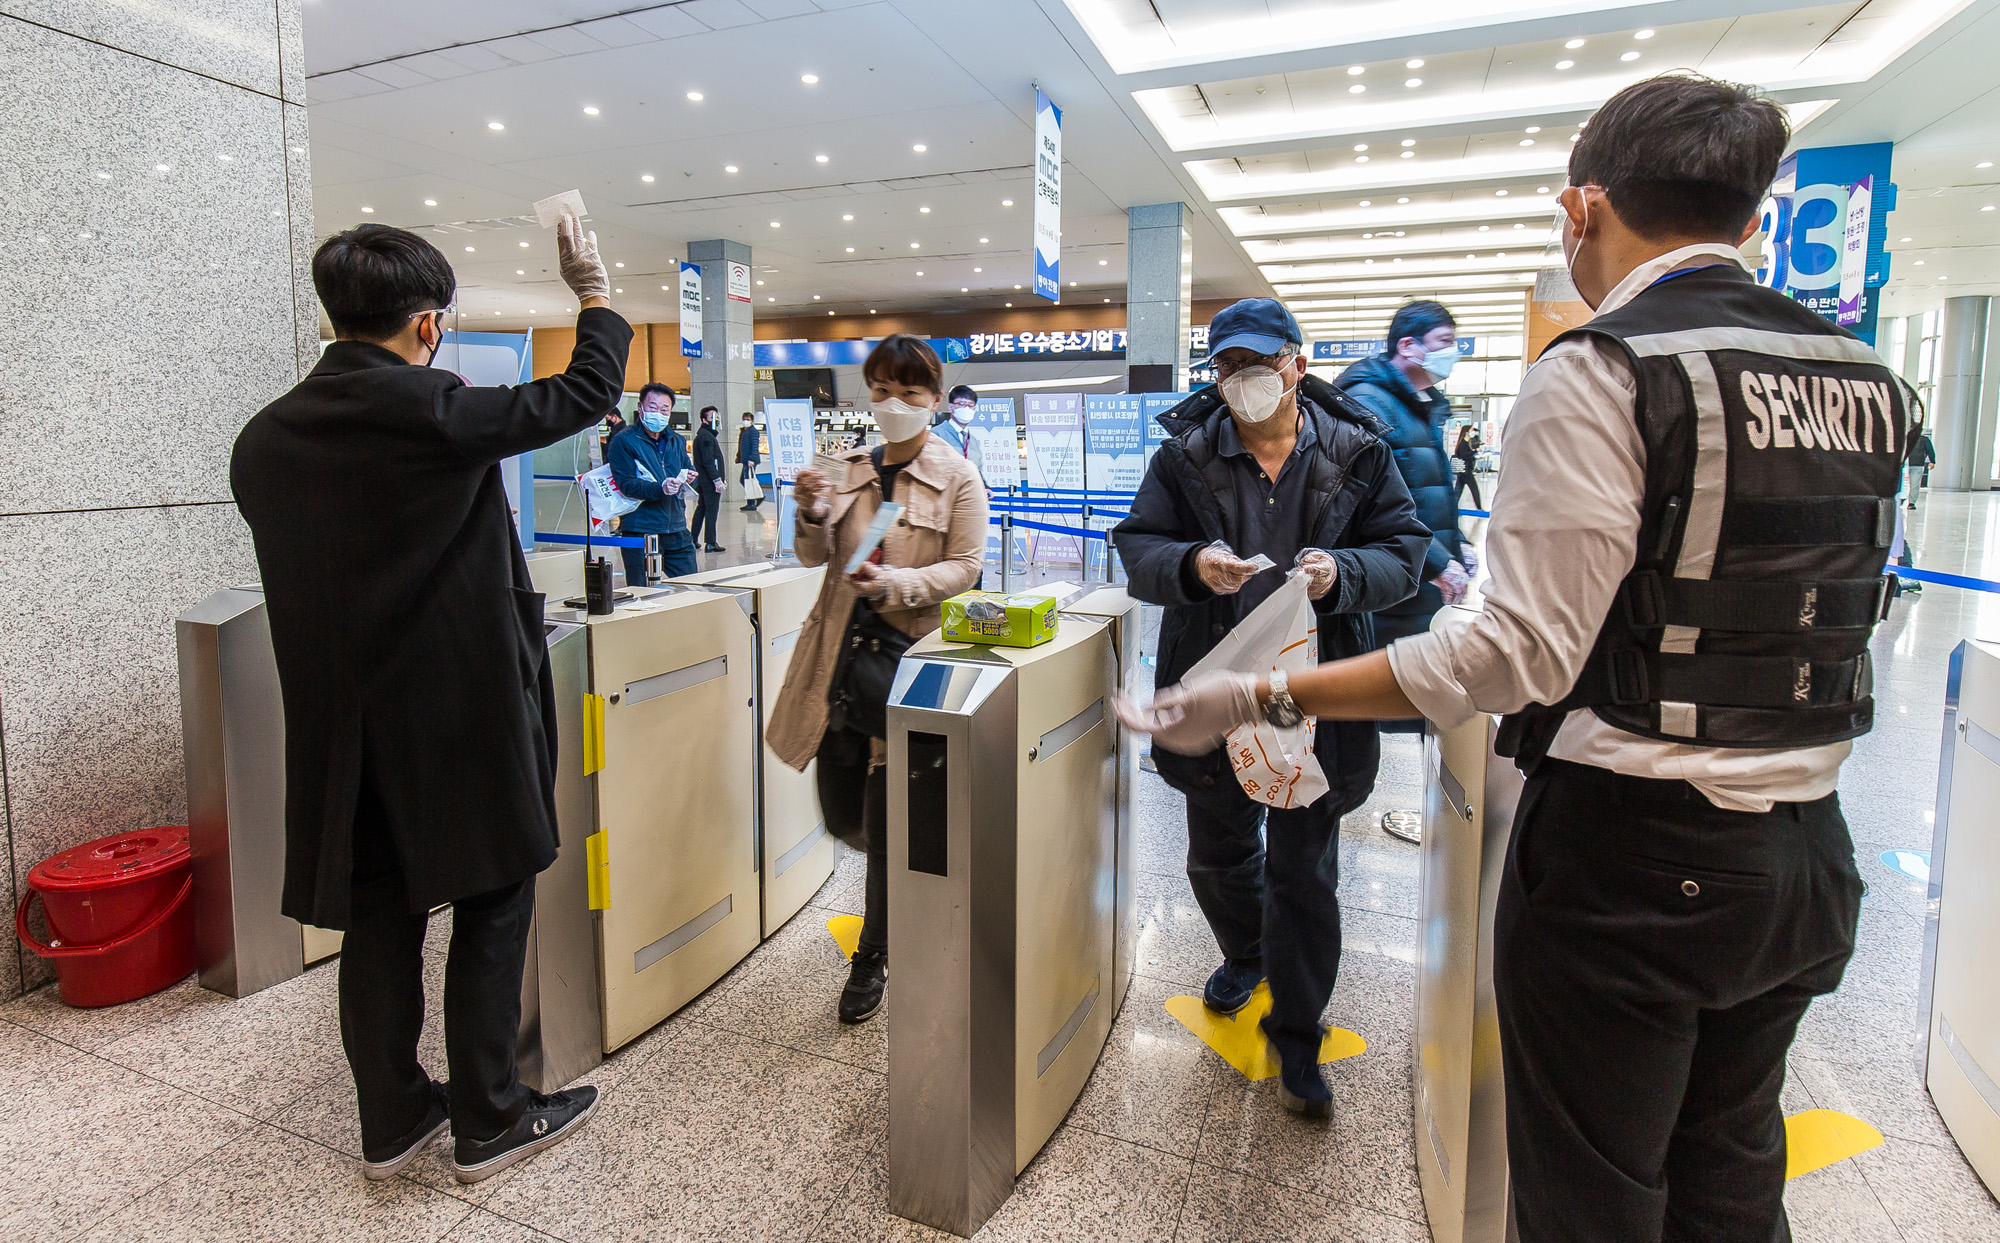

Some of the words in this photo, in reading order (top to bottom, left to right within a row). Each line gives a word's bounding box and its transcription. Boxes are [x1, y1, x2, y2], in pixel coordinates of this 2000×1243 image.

[1037, 274, 1058, 294] 동아전람
[683, 289, 700, 301] MBC
[969, 332, 1015, 355] 경기도
[1017, 328, 1114, 353] 우수중소기업
[759, 369, 773, 380] 세상
[1740, 370, 1895, 453] SECURITY
